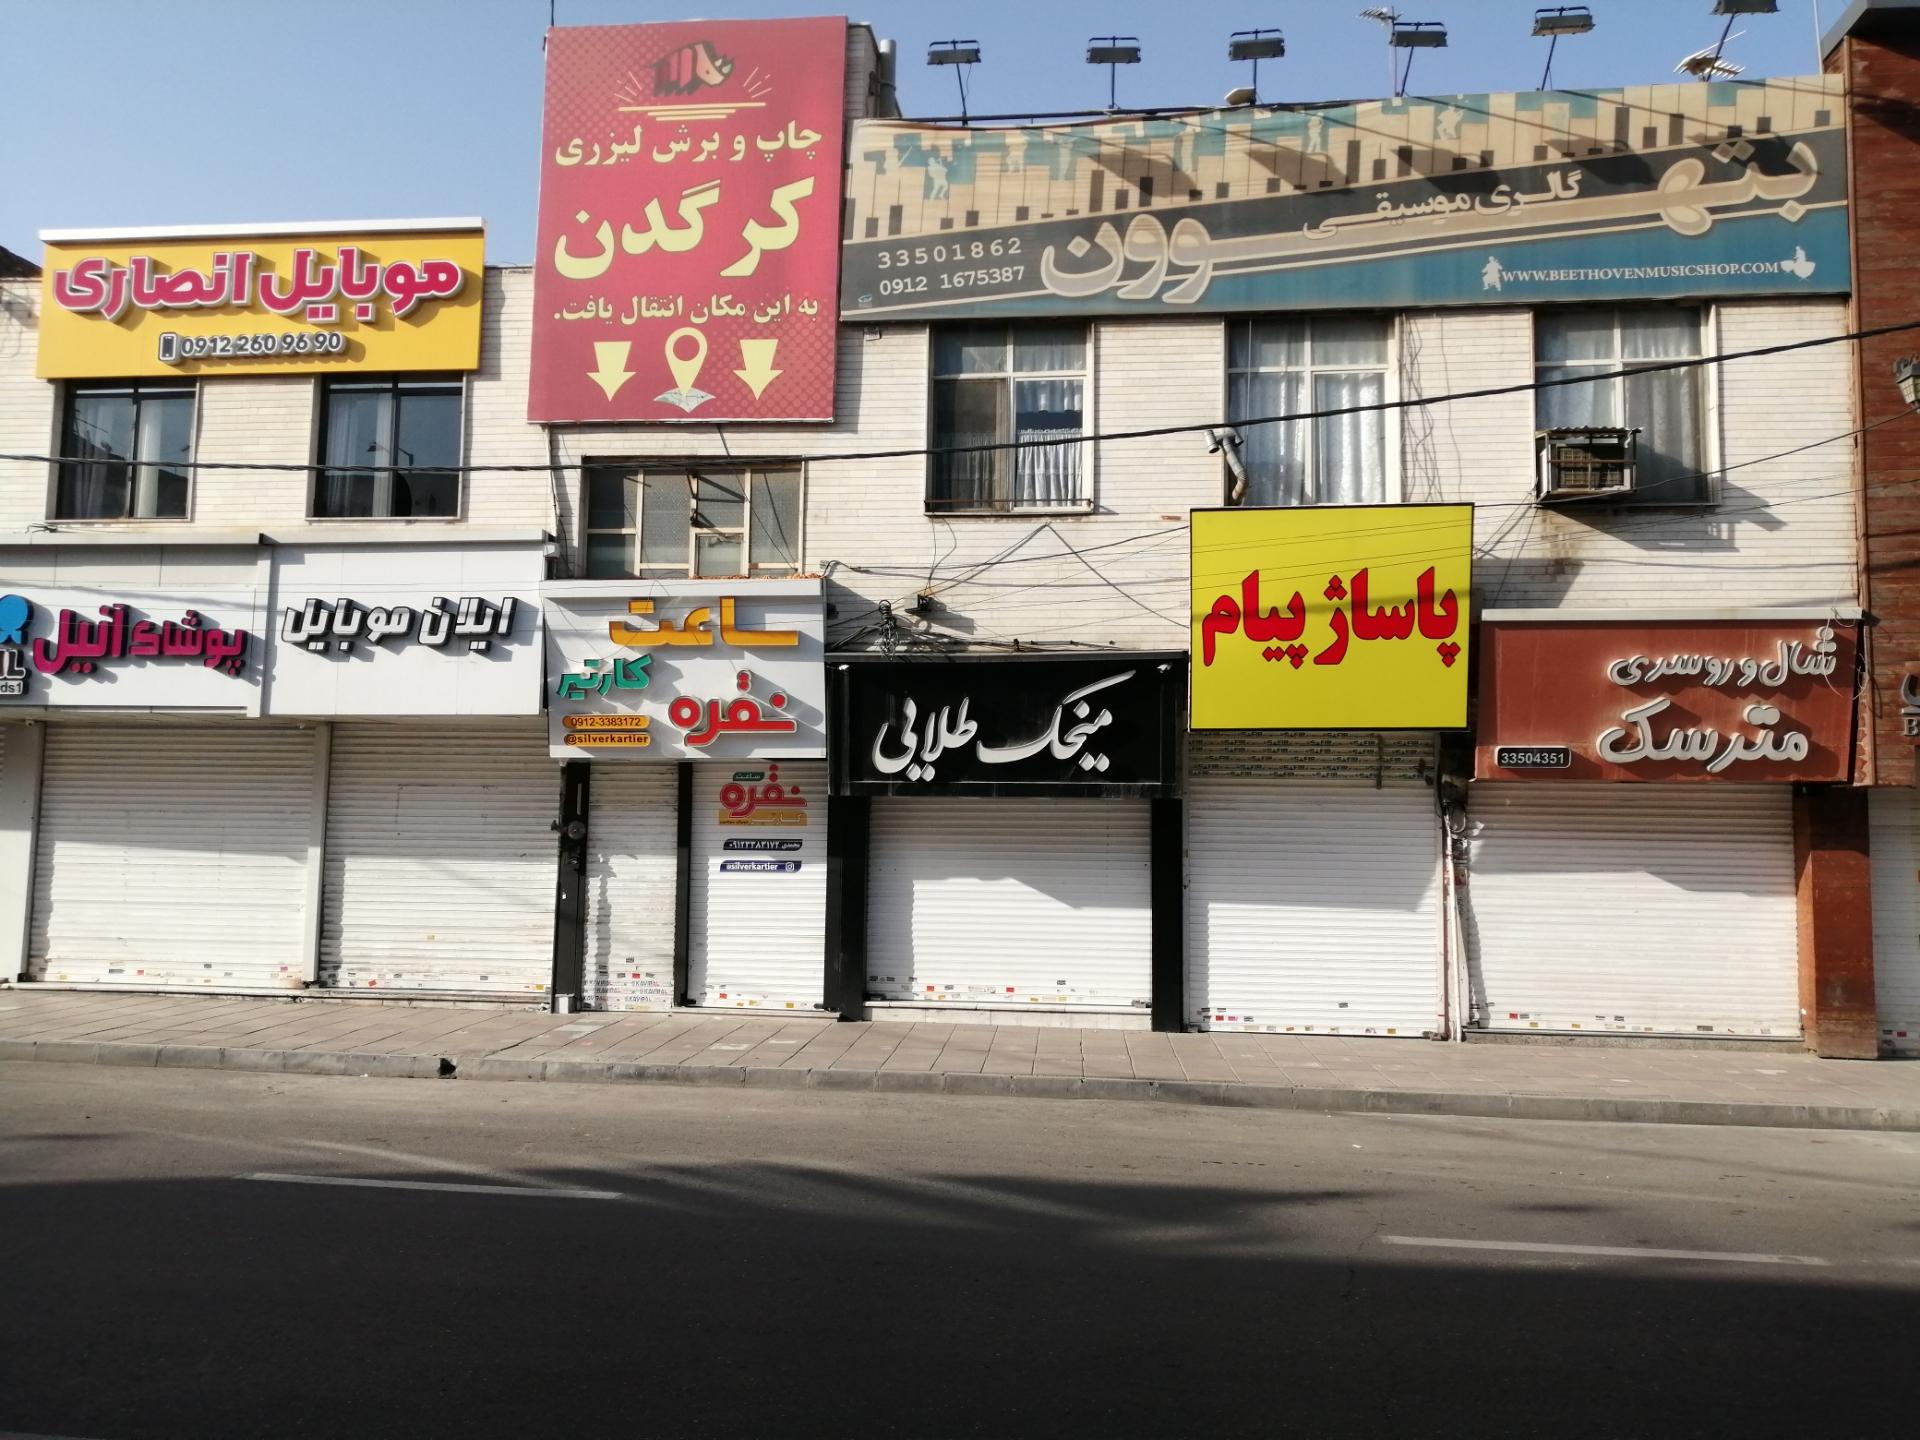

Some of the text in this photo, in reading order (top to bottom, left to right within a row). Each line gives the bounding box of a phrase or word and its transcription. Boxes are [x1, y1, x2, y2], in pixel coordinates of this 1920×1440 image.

[555, 120, 822, 166] چاپ و برش لیزری
[553, 176, 815, 279] کرگدن
[1303, 170, 1582, 240] گالری موسیقی
[877, 237, 1022, 269] 33501862
[1502, 261, 1779, 282] WWW.BEETHOVENMUSICSHOP.COM
[53, 246, 465, 322] موبایل انصاری
[879, 265, 1025, 296] 0912 1675387
[621, 295, 682, 325] انتقال
[690, 294, 745, 323] مکان
[753, 294, 791, 323] این
[798, 297, 818, 323] به
[181, 331, 343, 356] 0912 260 96 90
[281, 597, 416, 651] موبایل
[609, 596, 799, 646] ساعت
[1202, 566, 1461, 669] پاساژ پیام
[129, 609, 247, 676] پوشاک
[1608, 626, 1836, 687] شال و روسری
[557, 654, 653, 700] کارتیر
[570, 717, 641, 727] 0912-3383172
[668, 669, 797, 747] نقره
[977, 670, 1136, 772] میخک
[568, 734, 649, 745] @silverkartier
[1501, 752, 1564, 764] 33504351
[1596, 697, 1808, 773] مترسک
[719, 763, 807, 819] نقره
